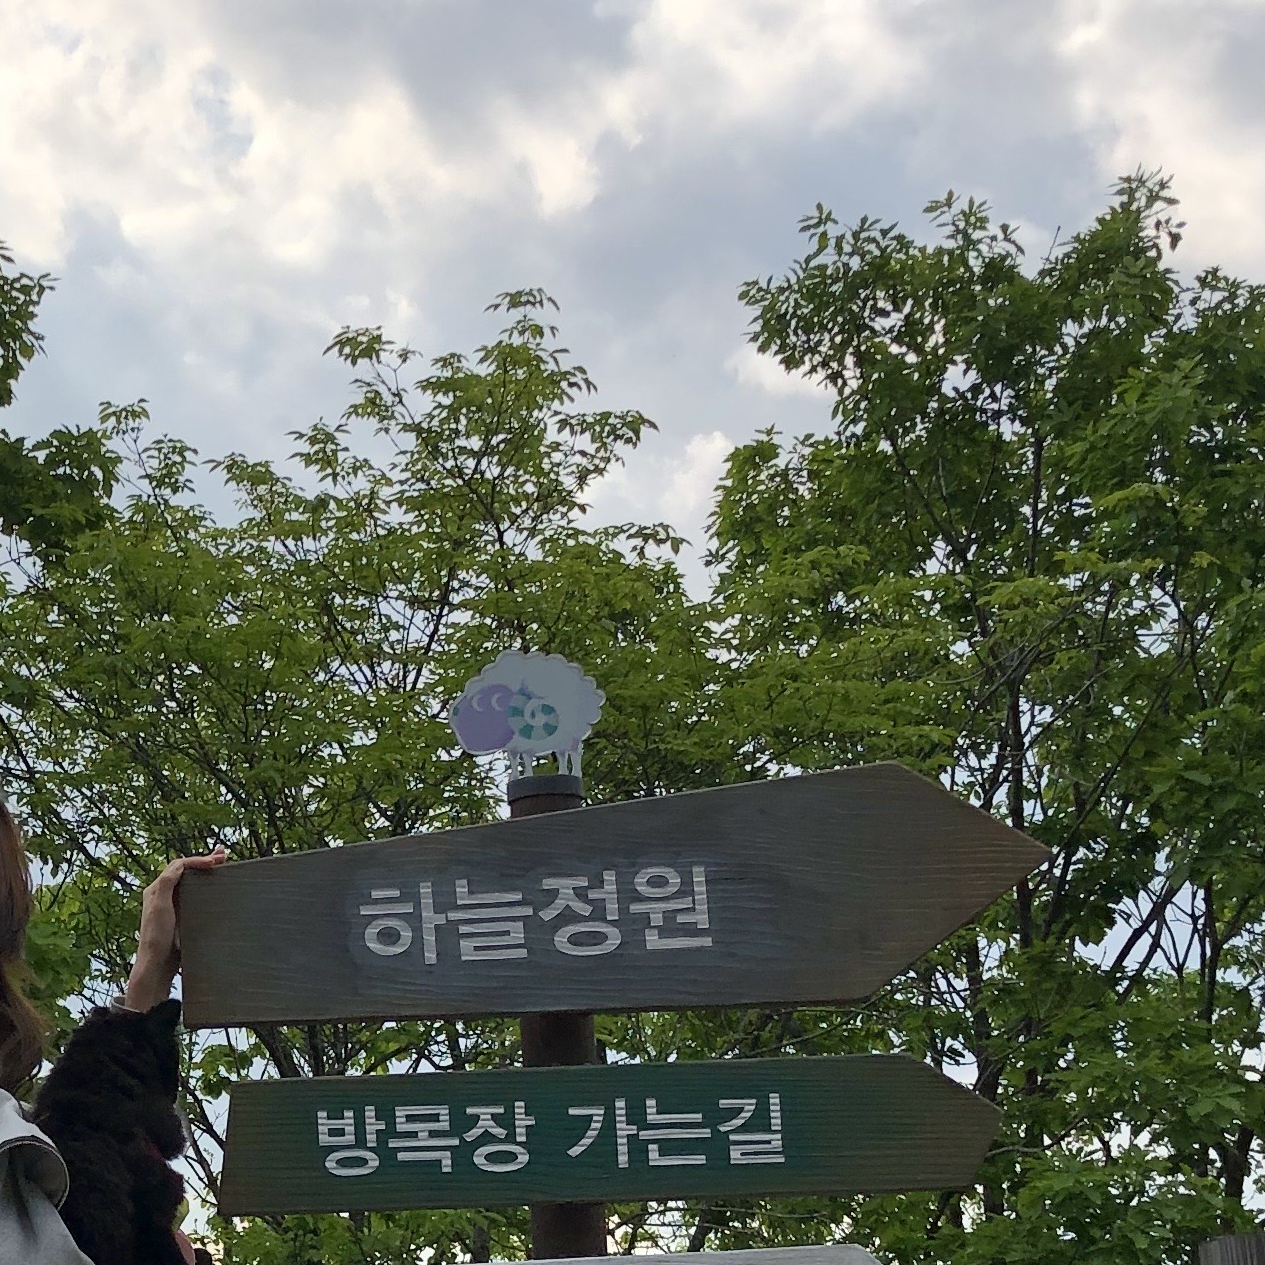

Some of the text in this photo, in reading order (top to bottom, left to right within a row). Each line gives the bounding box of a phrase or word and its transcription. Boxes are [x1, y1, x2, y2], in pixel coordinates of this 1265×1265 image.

[360, 864, 713, 965] 하늘정원
[316, 1092, 785, 1177] 방목장 가는길
